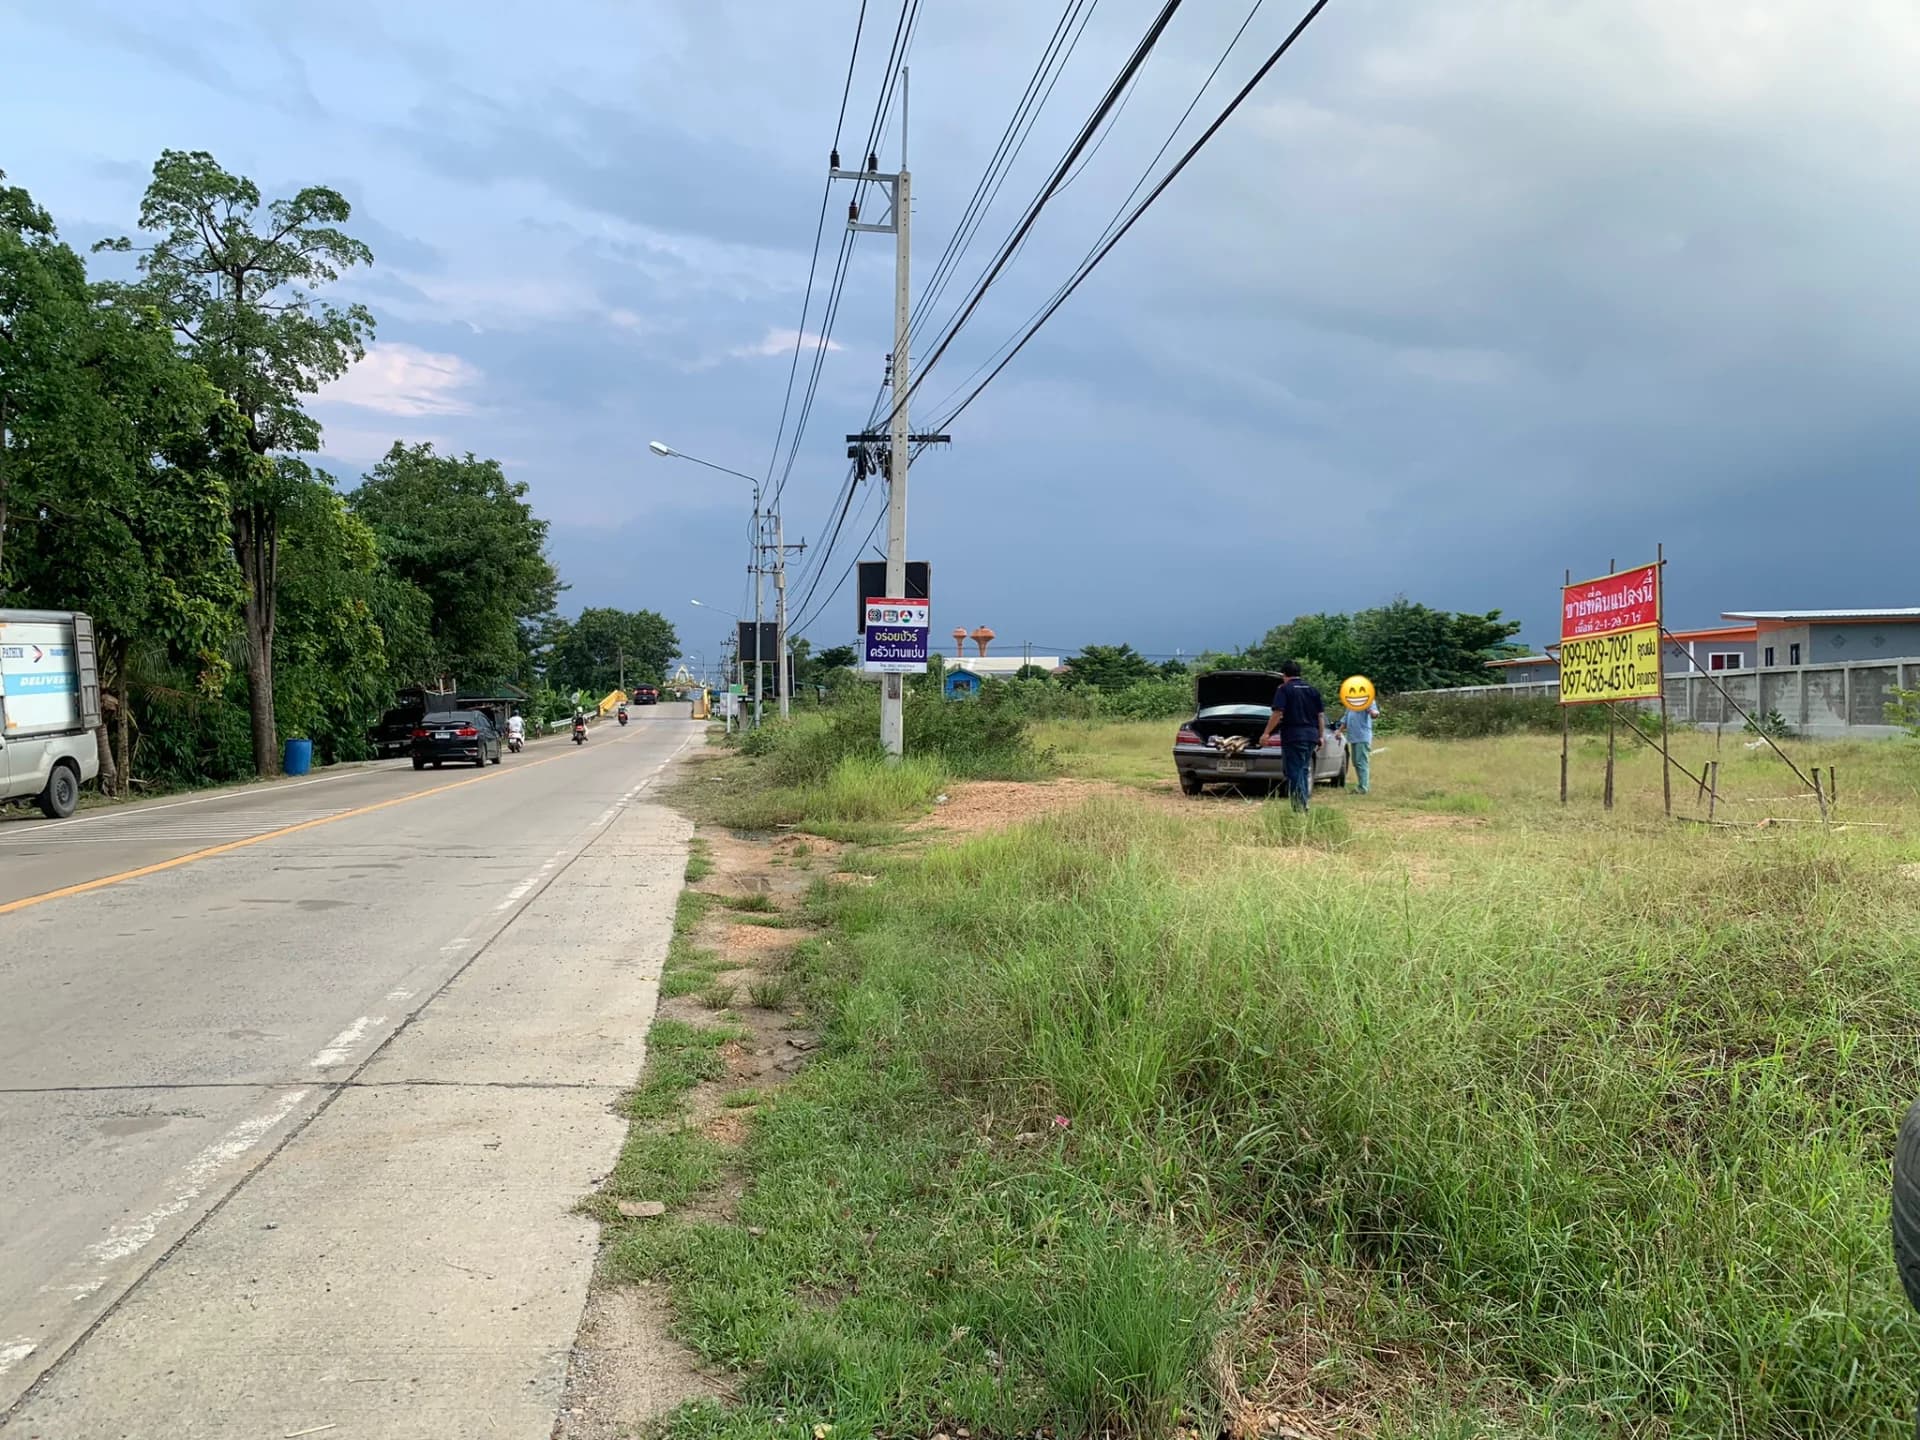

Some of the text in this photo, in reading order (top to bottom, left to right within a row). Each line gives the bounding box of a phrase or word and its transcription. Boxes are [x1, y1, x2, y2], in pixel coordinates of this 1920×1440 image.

[1566, 569, 1653, 618] ขายที่ดินแปลงนี้
[1575, 618, 1593, 633] เนื้อที่
[1631, 610, 1641, 623] ไร่
[1562, 634, 1633, 668] 099-029-7091
[1562, 663, 1635, 694] 097-056-4510
